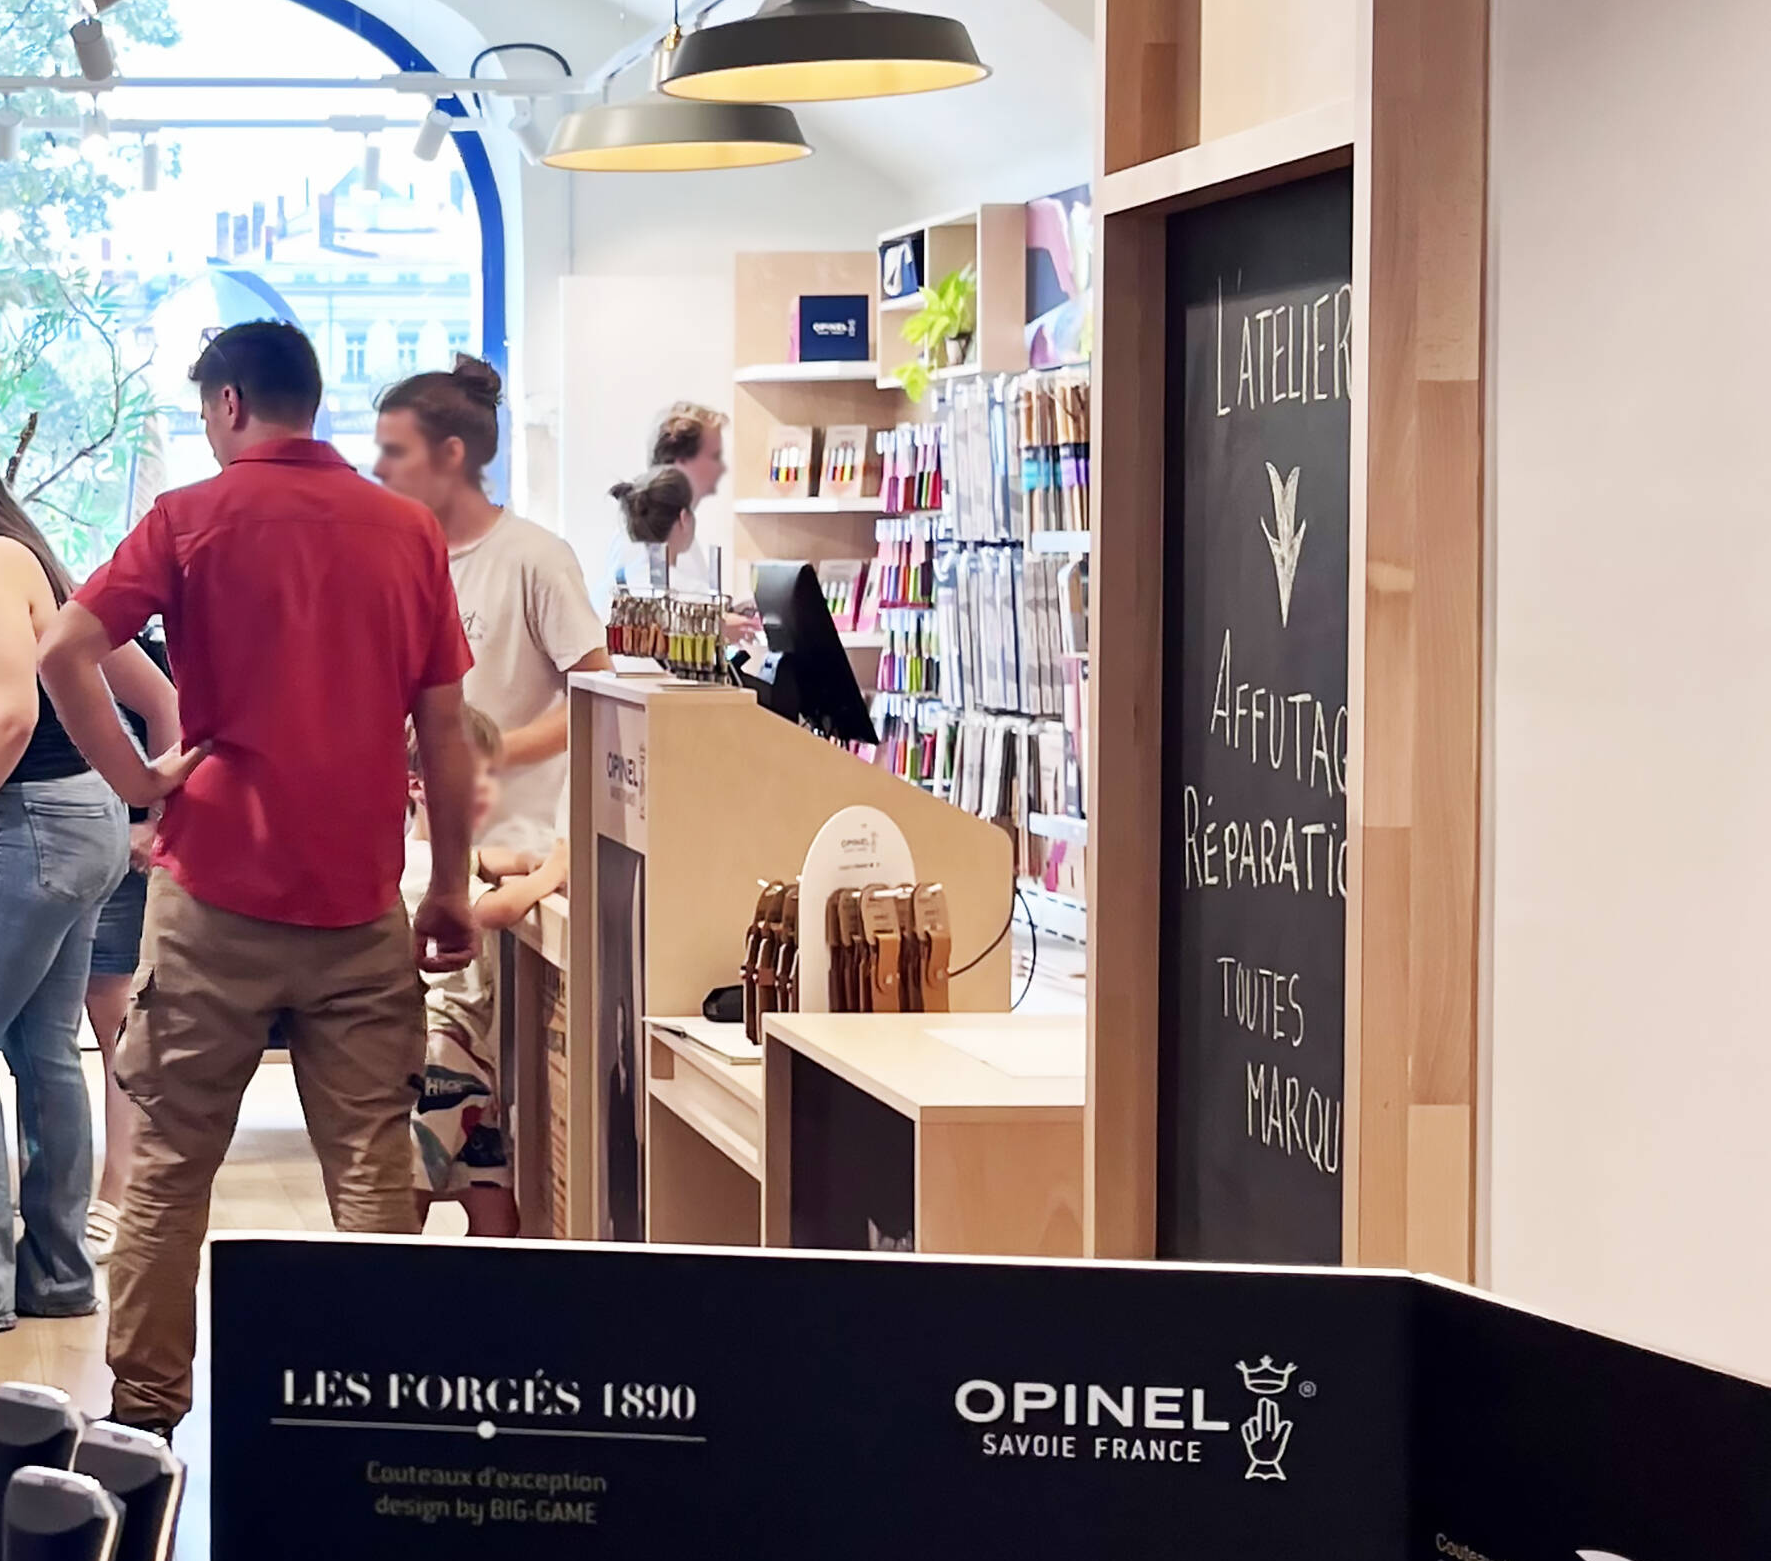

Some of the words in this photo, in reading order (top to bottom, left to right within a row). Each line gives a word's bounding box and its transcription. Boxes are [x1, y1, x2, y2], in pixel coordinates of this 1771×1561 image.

[1217, 268, 1352, 418] L'ATELIER
[1217, 956, 1305, 1047] TOUTES
[1246, 1061, 1341, 1174] MARQU
[284, 1369, 372, 1407] LES
[388, 1369, 581, 1416] FORGÉS
[603, 1383, 696, 1420] 1890
[955, 1379, 1230, 1432] OPINEL
[983, 1432, 1077, 1458] SAVOIE
[1094, 1437, 1202, 1463] FRANCE
[366, 1460, 473, 1486] Couteaux
[476, 1466, 608, 1497] d'exception
[374, 1494, 450, 1523] design
[455, 1497, 485, 1526] by
